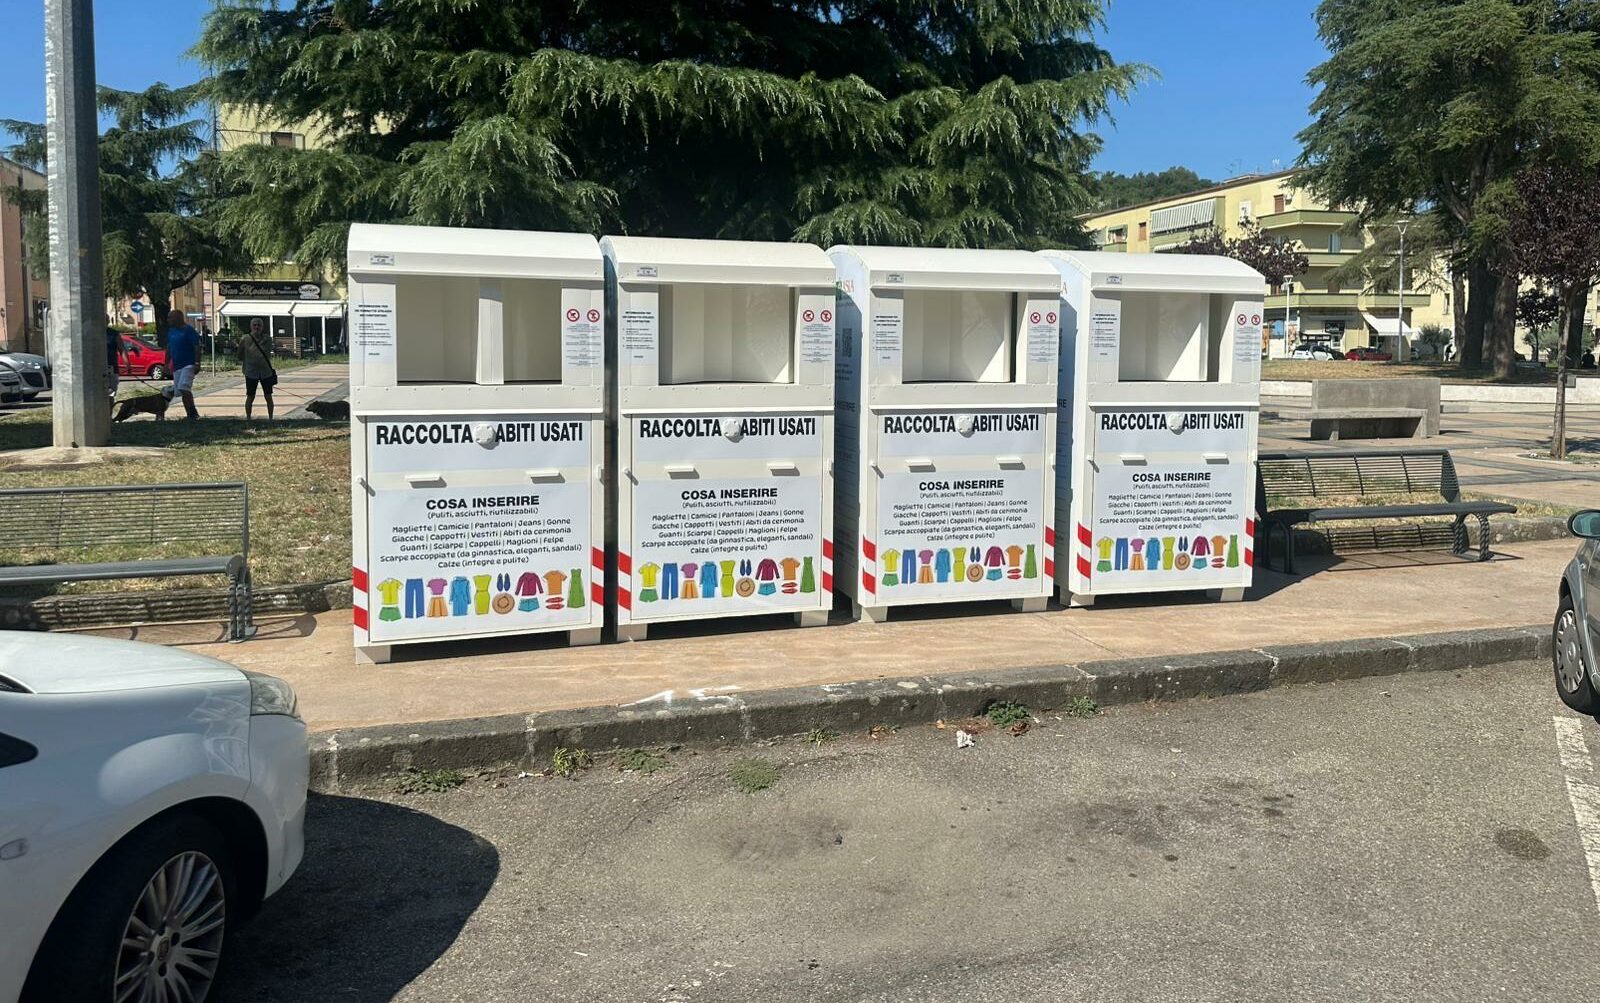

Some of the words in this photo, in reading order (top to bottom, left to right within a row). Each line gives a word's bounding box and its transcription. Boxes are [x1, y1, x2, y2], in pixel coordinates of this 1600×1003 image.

[640, 418, 722, 438] RACCOLTA
[739, 418, 775, 436] ABITI
[779, 417, 815, 436] USATI
[885, 416, 956, 434] RACCOLTA
[971, 415, 1003, 432] ABITI
[1006, 415, 1039, 432] USATI
[1102, 413, 1167, 430] RACCOLTA
[1181, 413, 1211, 429] ABITI
[1214, 413, 1244, 429] USATI
[376, 424, 474, 445] RACCOLTA
[494, 423, 535, 443] ABITI
[541, 422, 583, 442] USATI
[1132, 474, 1161, 483] COSA
[1164, 473, 1211, 482] INSERIRE
[919, 481, 950, 491] COSA
[953, 479, 1004, 490] INSERIRE
[681, 489, 716, 500] COSA
[720, 487, 778, 498] INSERIRE
[426, 499, 468, 510] COSA
[472, 495, 539, 508] INSERIRE
[734, 498, 777, 506] riutilizzabili)
[428, 511, 454, 520] (Puliti,
[455, 509, 488, 518] asciutti,
[489, 507, 538, 516] riutilizzabili)
[652, 514, 686, 522] Magliette
[722, 510, 755, 518] Pantaloni
[392, 525, 432, 534] Magliette
[438, 523, 470, 531] Camicie
[475, 520, 513, 529] Pantaloni
[652, 522, 679, 530] Giacche
[684, 521, 714, 529] Cappotti
[772, 517, 804, 525] cerimonia
[392, 534, 425, 543] Giacche
[430, 532, 466, 541] Cappotti
[471, 530, 498, 539] Vestiti
[534, 527, 571, 535] cerimonia
[658, 531, 682, 539] Guanti
[717, 528, 744, 536] Cappelli
[749, 527, 776, 535] Maglioni
[400, 543, 428, 552] Guanti
[433, 542, 464, 550] Sciarpe
[469, 539, 501, 548] Cappelli
[506, 537, 538, 546] Maglioni
[543, 536, 564, 544] Felpe
[642, 541, 666, 549] Scarpe
[667, 539, 706, 547] accoppiate
[787, 533, 813, 541] sandali)
[380, 555, 409, 563] Scarpe
[410, 552, 456, 561] accoppiate
[457, 551, 471, 559] (da
[471, 549, 515, 558] ginnastica,
[516, 546, 551, 555] eleganti,
[552, 544, 582, 552] sandali)
[745, 544, 768, 553] pulite)
[462, 559, 495, 568] (integre
[503, 556, 529, 566] pulite)
